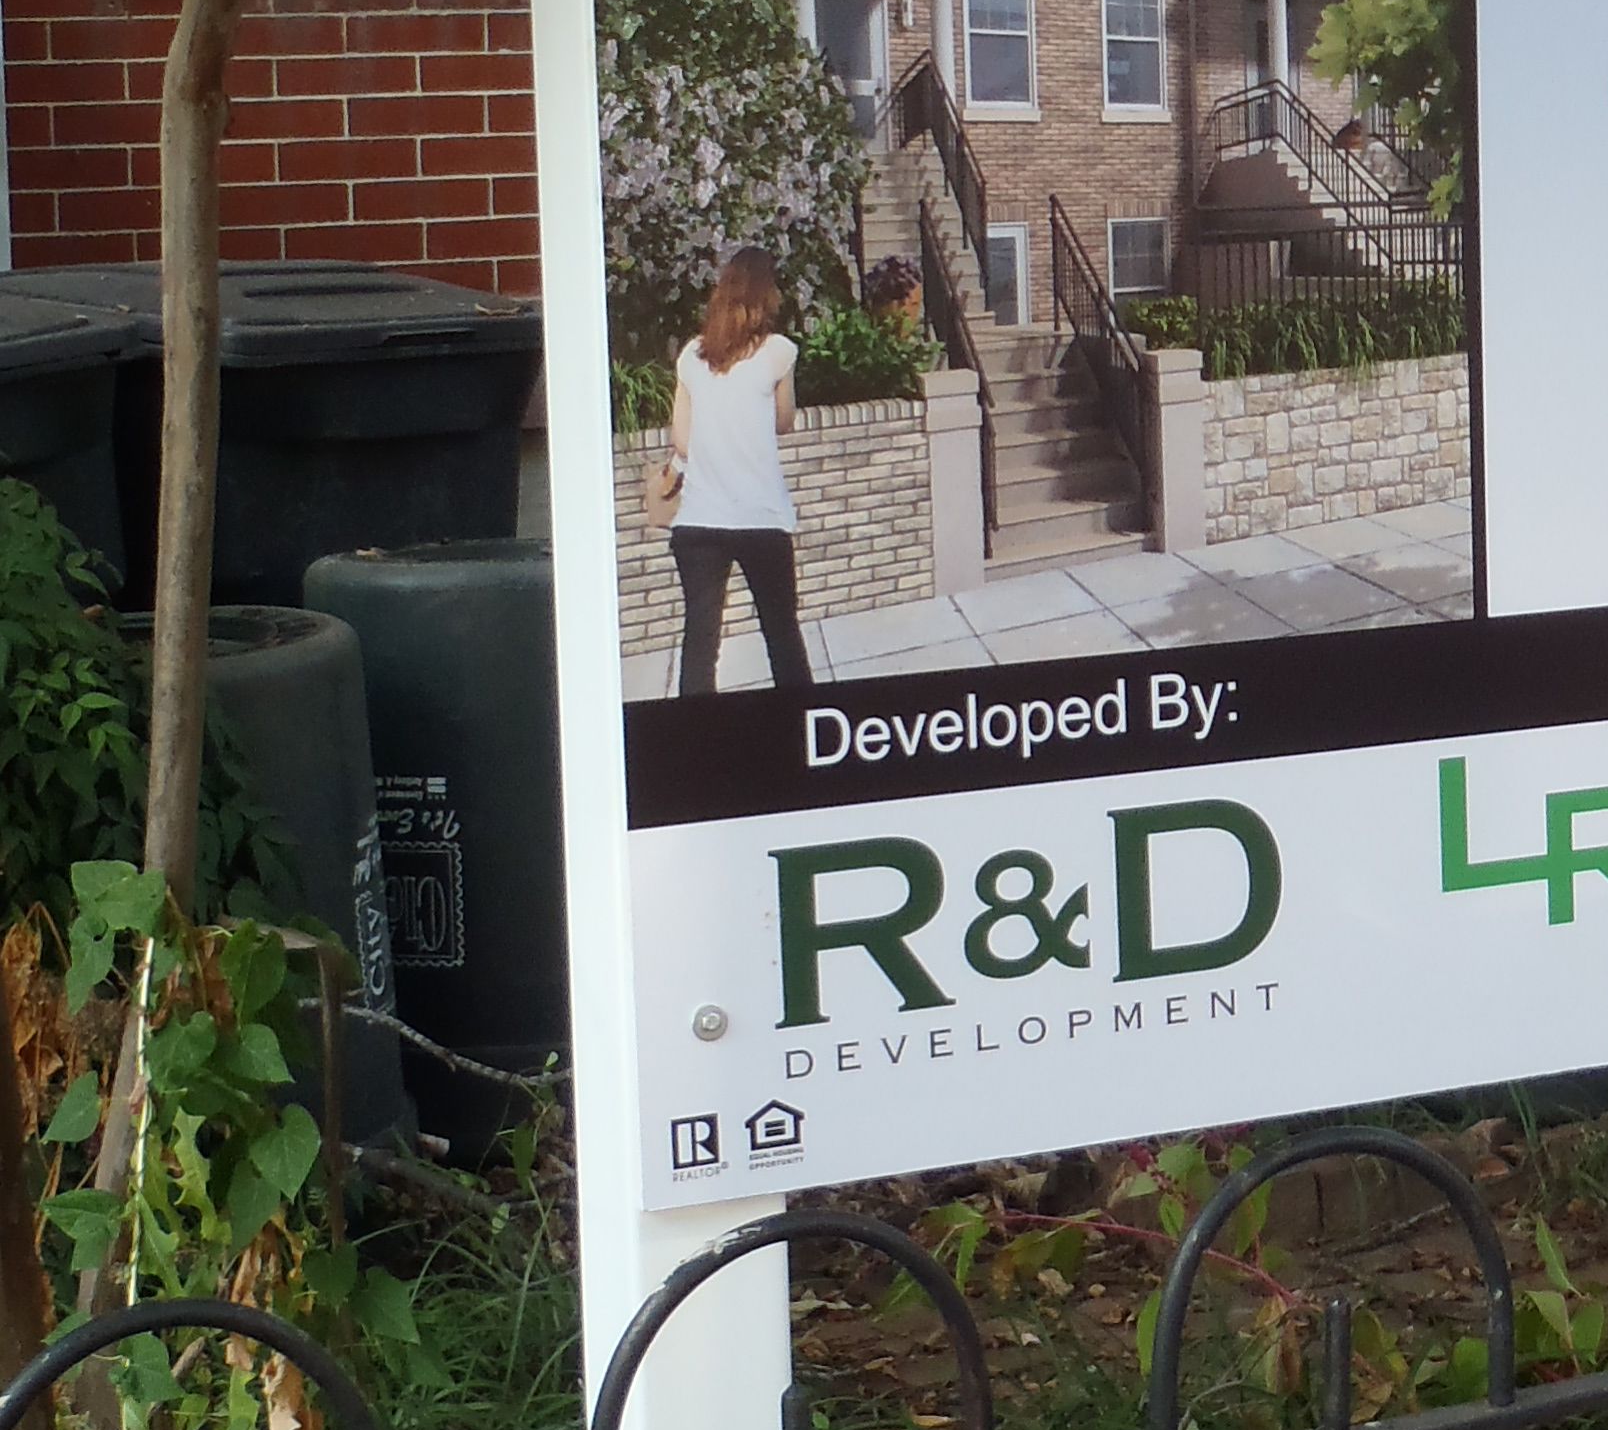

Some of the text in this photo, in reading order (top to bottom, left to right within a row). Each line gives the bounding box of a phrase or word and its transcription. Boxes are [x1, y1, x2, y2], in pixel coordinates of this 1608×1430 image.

[806, 674, 1237, 766] Developed By:
[768, 800, 1281, 1031] R&D
[786, 984, 1278, 1079] DEVELOPMENT
[748, 1156, 804, 1171] OPPORTUNITY
